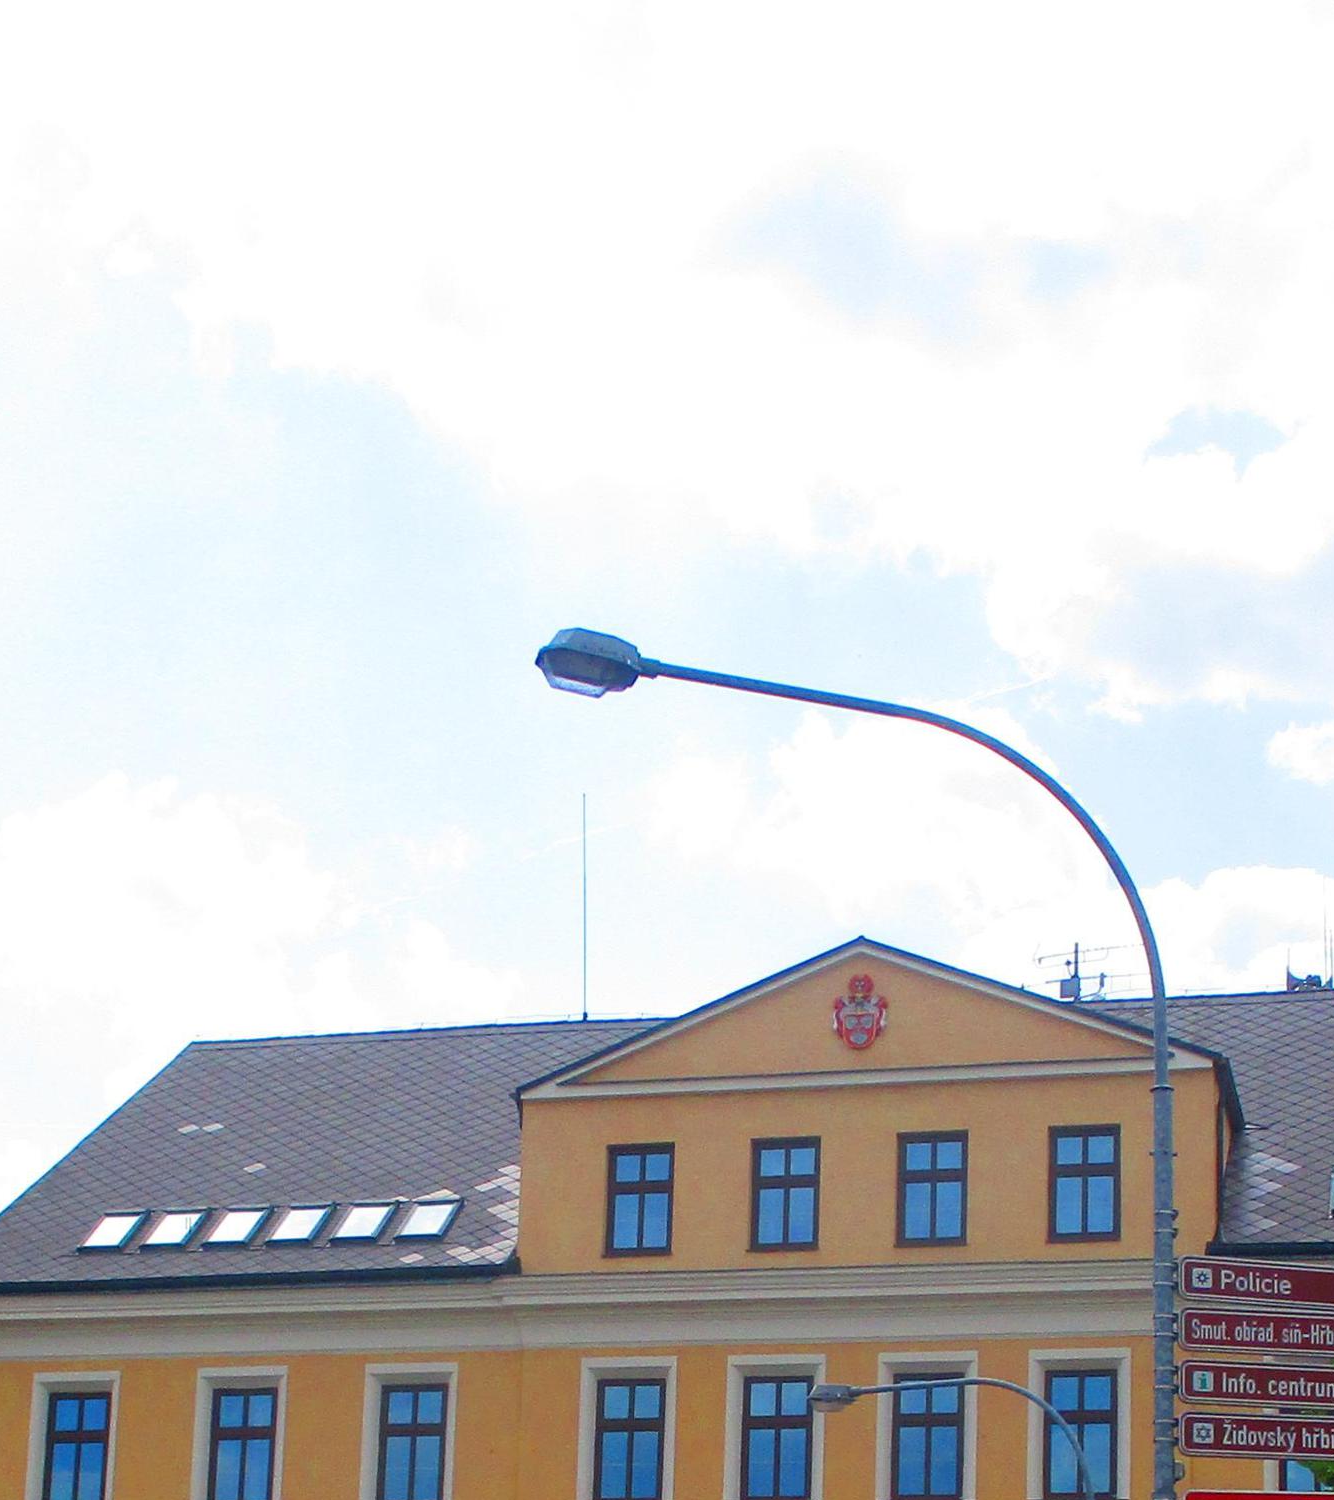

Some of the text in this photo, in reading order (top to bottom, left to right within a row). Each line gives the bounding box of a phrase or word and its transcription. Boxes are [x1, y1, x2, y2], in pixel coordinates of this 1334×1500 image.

[1221, 1269, 1292, 1295] Policie
[1191, 1318, 1231, 1341] Smut.
[1234, 1319, 1278, 1343] obřad.
[1222, 1372, 1261, 1395] Info.
[1222, 1419, 1296, 1453] Židovský
